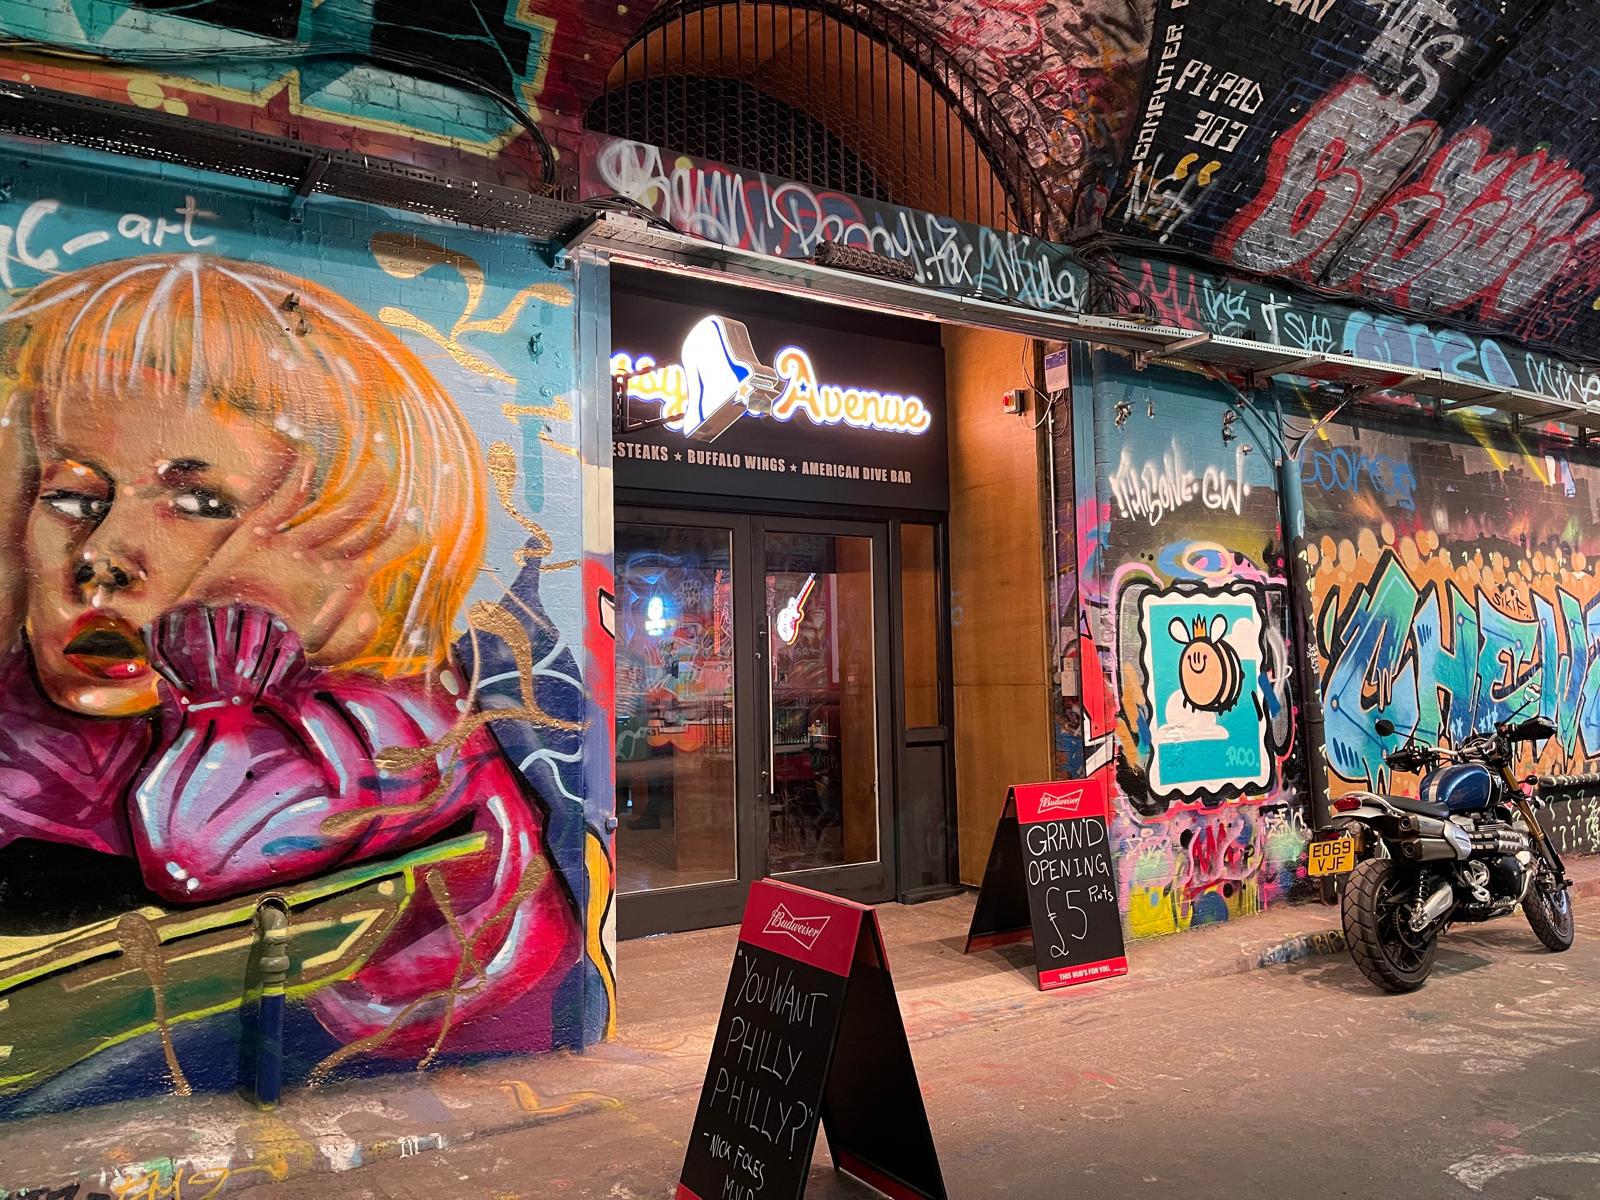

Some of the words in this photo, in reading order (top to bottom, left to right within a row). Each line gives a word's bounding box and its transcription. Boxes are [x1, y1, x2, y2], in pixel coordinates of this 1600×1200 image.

[774, 346, 932, 434] Avenue
[687, 448, 741, 468] BUFFALO
[744, 455, 786, 473] WINGS
[801, 461, 860, 480] AMERICAN
[862, 466, 888, 482] DIVE
[890, 469, 912, 484] BAR
[1026, 818, 1104, 856] GRAND
[1028, 853, 1110, 886] OPENING
[1317, 856, 1345, 873] VJF
[771, 910, 821, 938] Budweiser
[1046, 886, 1088, 958] £5
[1059, 971, 1072, 980] THIS
[1072, 969, 1088, 979] BUD'S
[1088, 967, 1100, 976] FOR
[769, 965, 828, 1027] WANT
[724, 1016, 803, 1085] PHILLY
